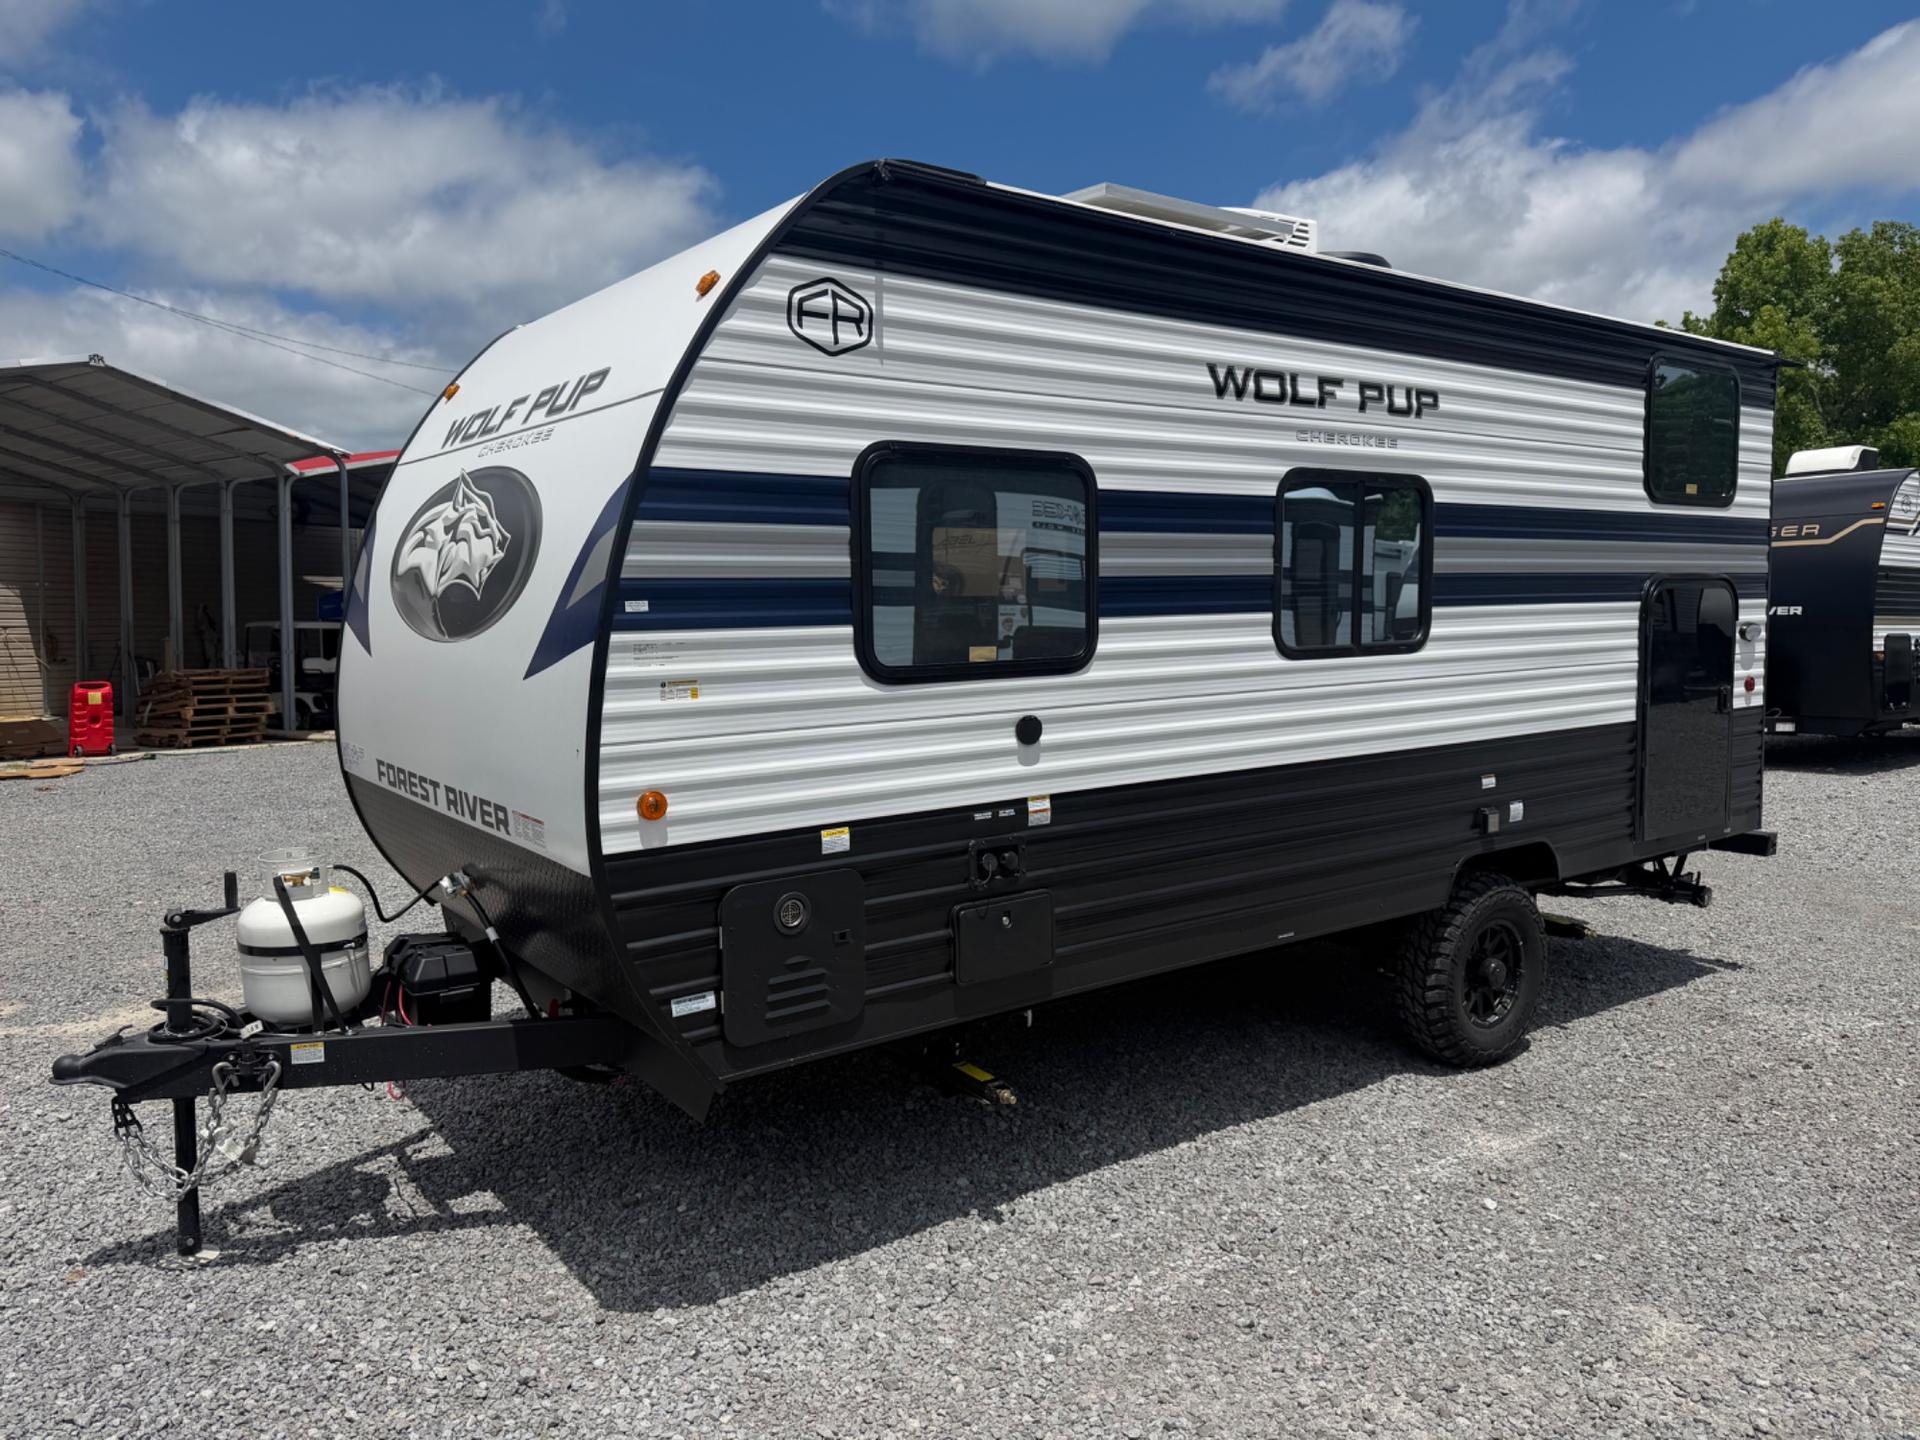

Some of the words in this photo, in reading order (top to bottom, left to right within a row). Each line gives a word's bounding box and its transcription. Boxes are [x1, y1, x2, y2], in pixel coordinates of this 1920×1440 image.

[441, 394, 531, 449] WOLF
[522, 366, 612, 425] PUP
[1206, 362, 1344, 410] WOLF
[1358, 380, 1441, 419] PUP
[477, 426, 555, 458] CHEROKEE
[1296, 430, 1399, 449] CHEROKEE
[376, 758, 441, 806] FOREST
[444, 784, 511, 836] RIVER
